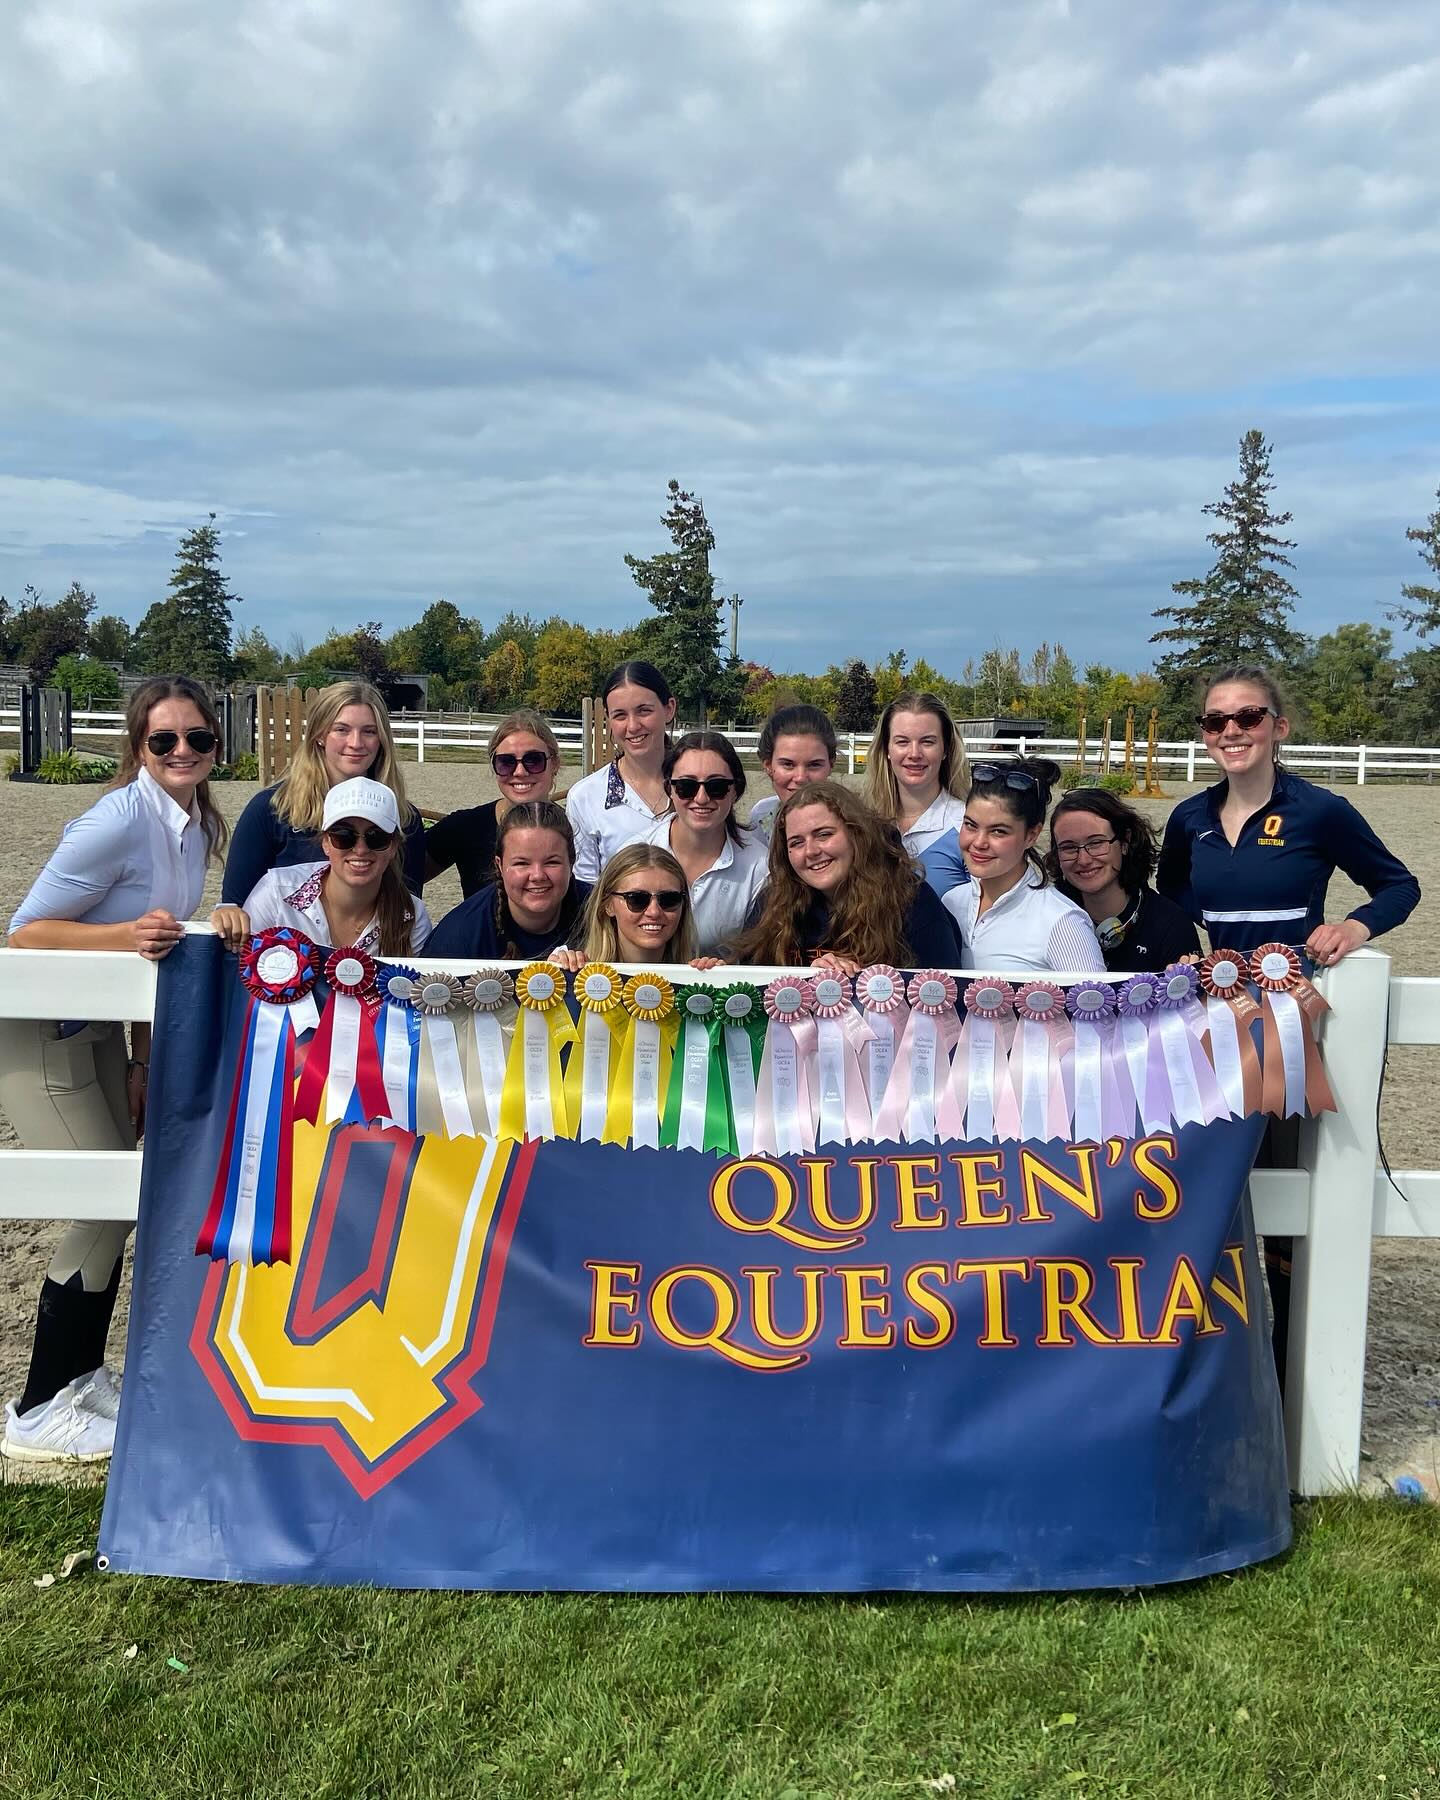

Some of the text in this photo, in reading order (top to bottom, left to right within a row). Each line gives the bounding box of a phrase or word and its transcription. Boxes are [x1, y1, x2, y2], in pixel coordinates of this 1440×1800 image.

[1264, 815, 1282, 837] Q
[711, 1136, 1181, 1250] QUEEN'S
[584, 1245, 1249, 1371] EQUESTRIAN
